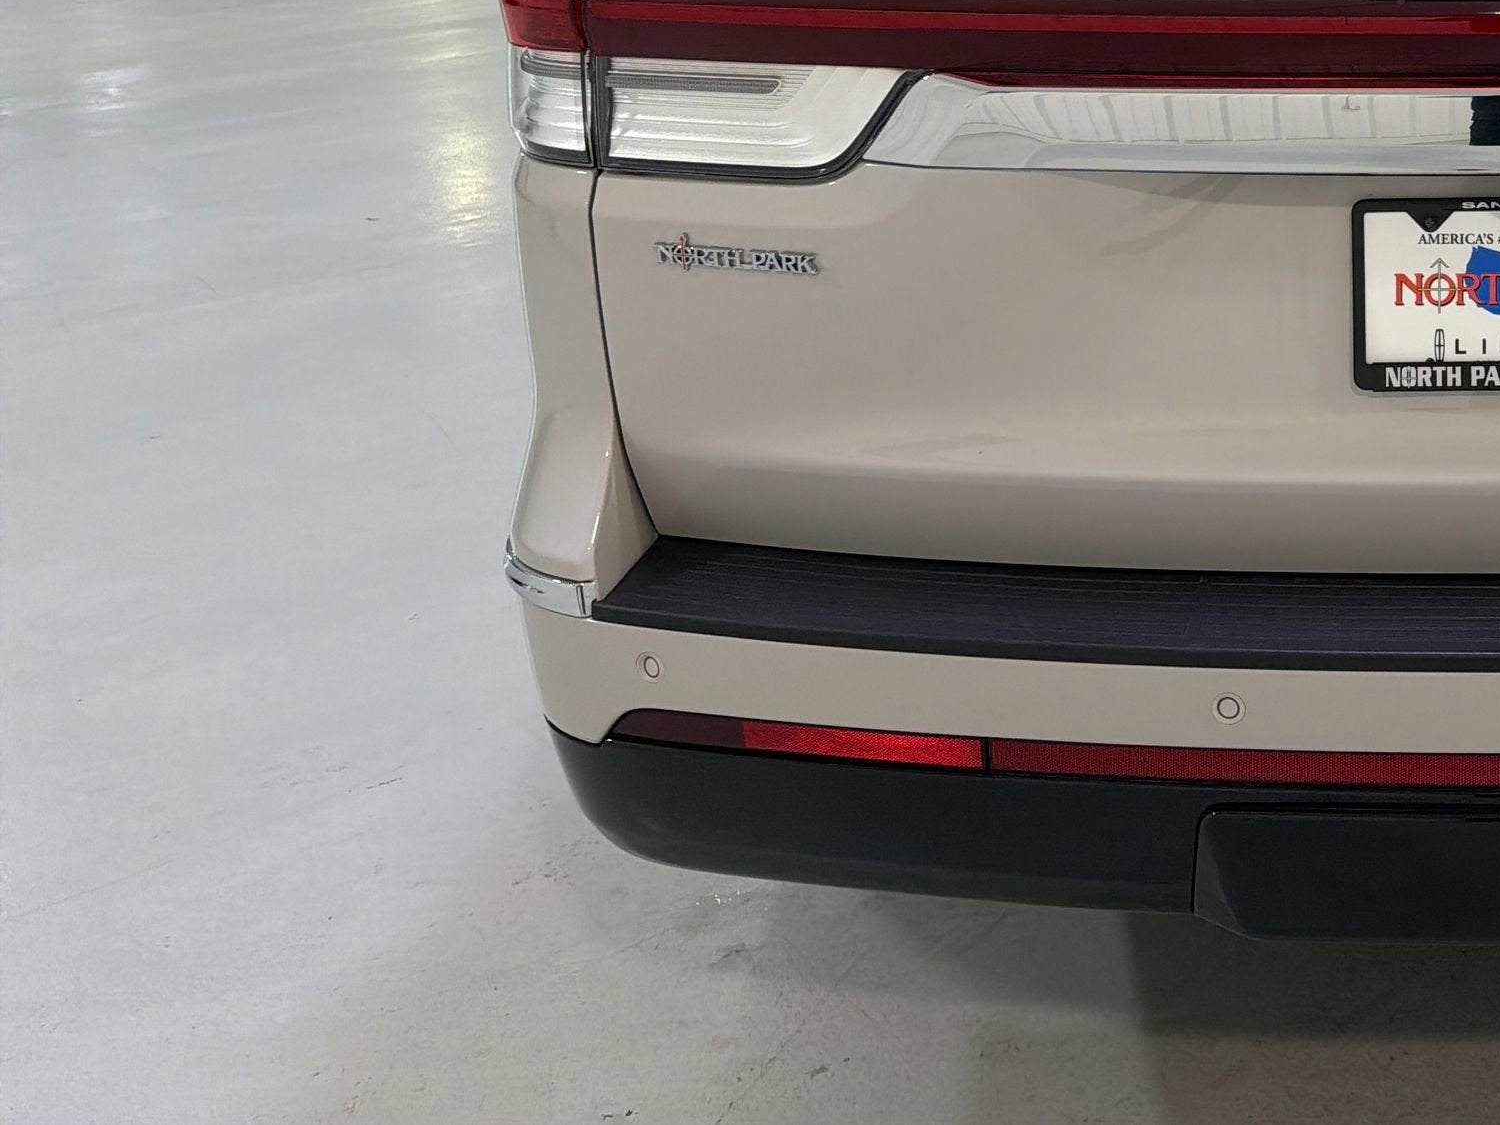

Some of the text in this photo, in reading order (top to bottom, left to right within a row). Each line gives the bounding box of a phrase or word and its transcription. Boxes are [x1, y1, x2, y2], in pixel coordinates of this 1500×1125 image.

[1417, 232, 1494, 245] AMERICA'S
[654, 242, 820, 275] NORTH PARK
[1385, 365, 1462, 388] NORTH
